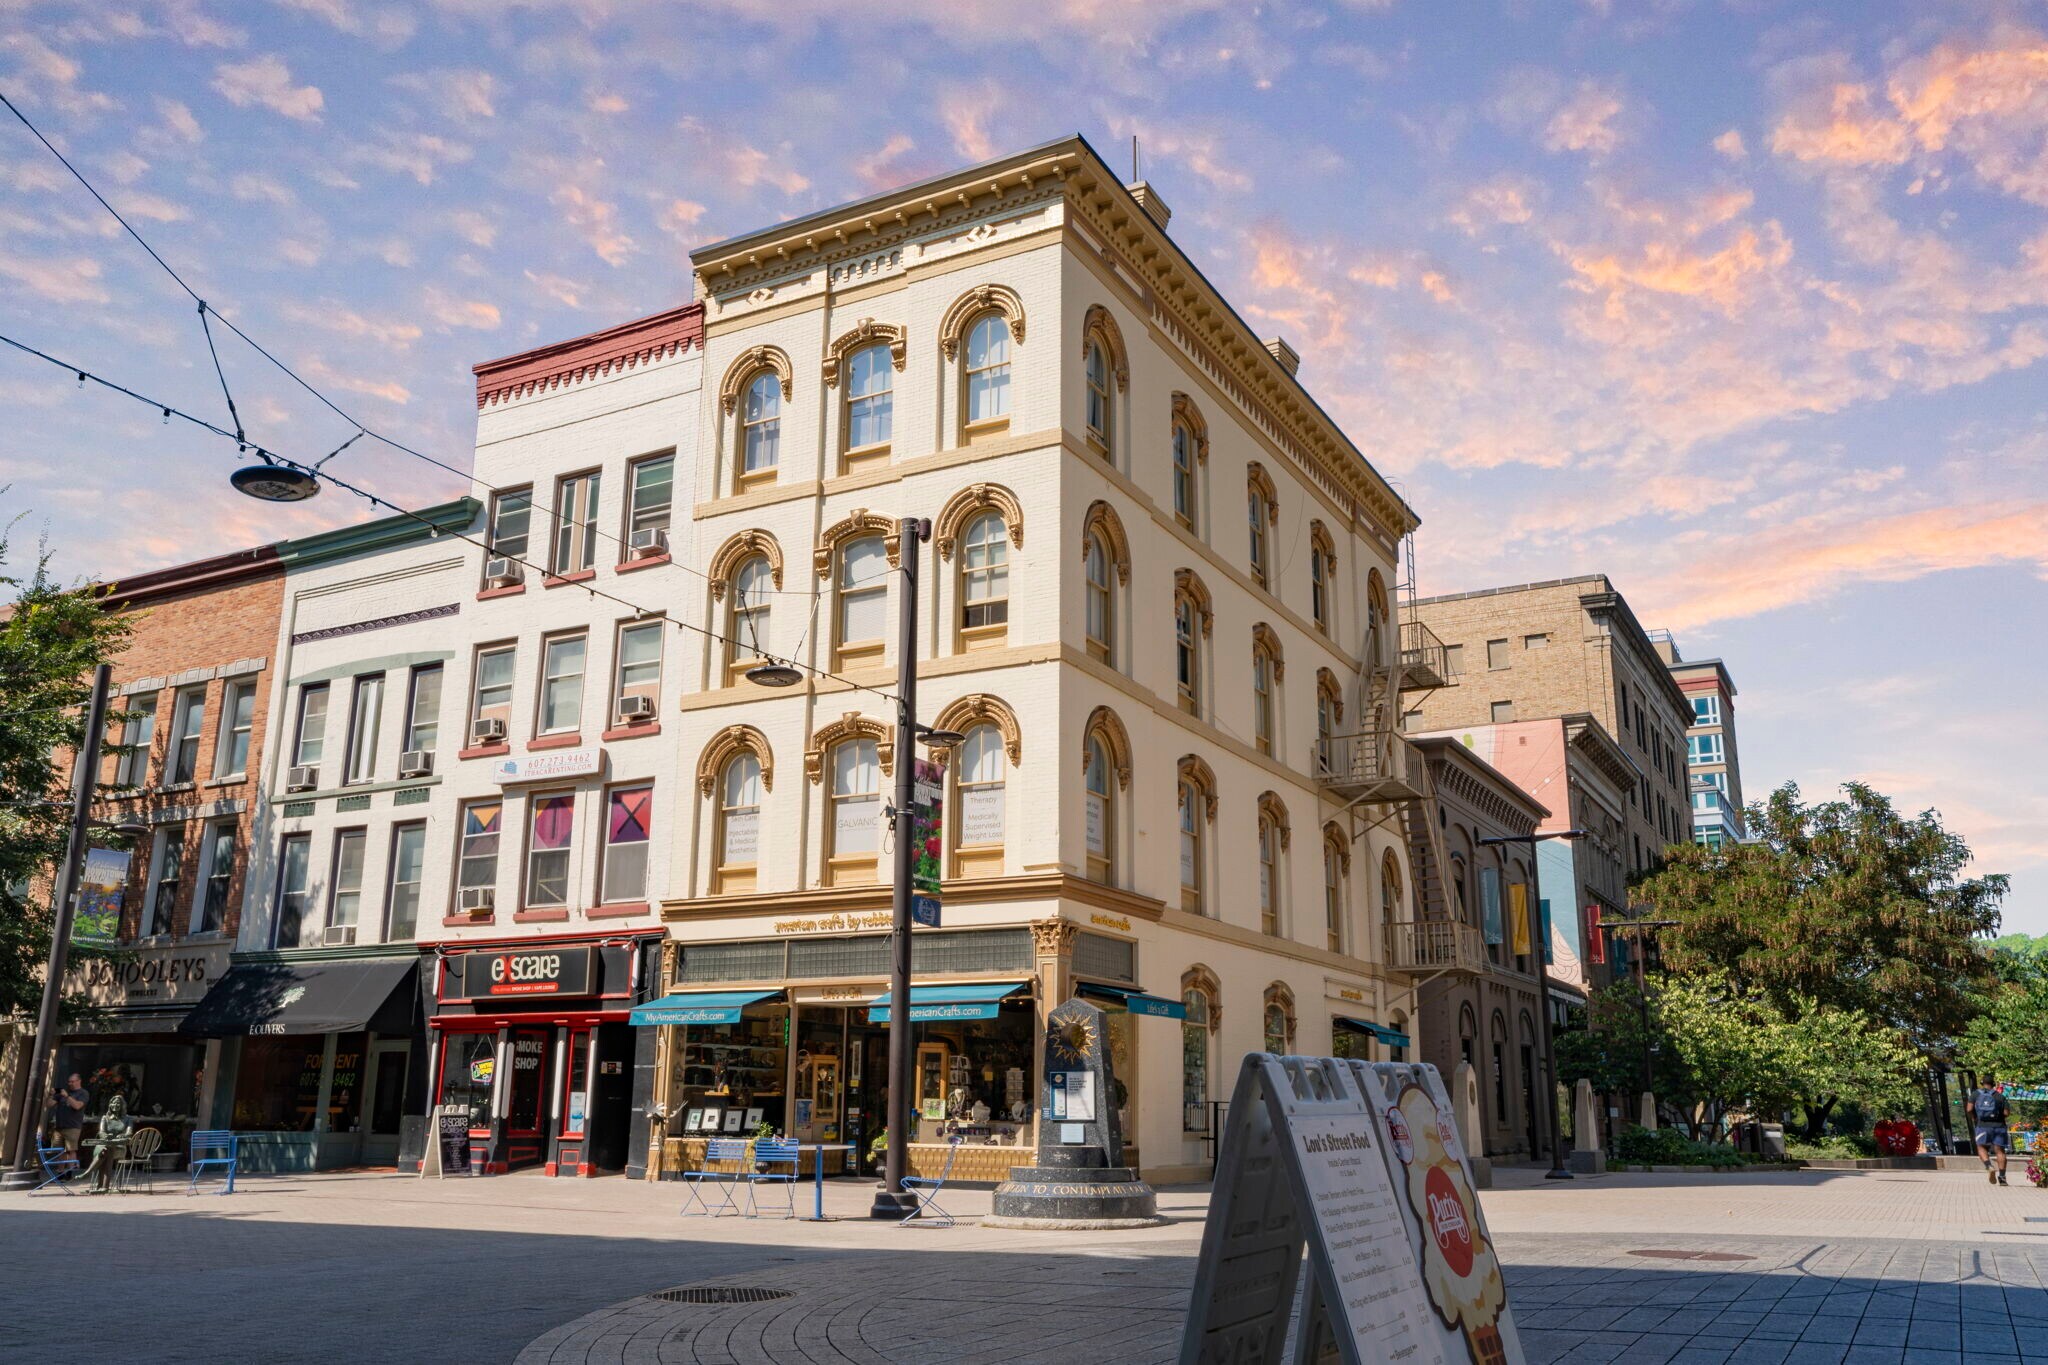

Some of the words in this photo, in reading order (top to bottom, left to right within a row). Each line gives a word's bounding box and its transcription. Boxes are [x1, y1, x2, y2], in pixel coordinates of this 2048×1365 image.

[969, 797, 997, 805] Therapy
[838, 816, 878, 829] GALVANIC
[968, 812, 999, 821] Medically
[965, 821, 1001, 831] Supervised
[846, 913, 861, 931] by
[87, 957, 207, 987] SCHOOLEYS
[645, 1009, 725, 1023] MyAmericanCrafts.com
[334, 1053, 359, 1069] ENT
[515, 1057, 538, 1070] SHOP
[1303, 1133, 1328, 1153] Lou's
[1326, 1132, 1352, 1151] Street
[1350, 1131, 1371, 1150] Food
[1033, 1184, 1047, 1194] TO
[1053, 1184, 1126, 1195] CONTEMPLATE
